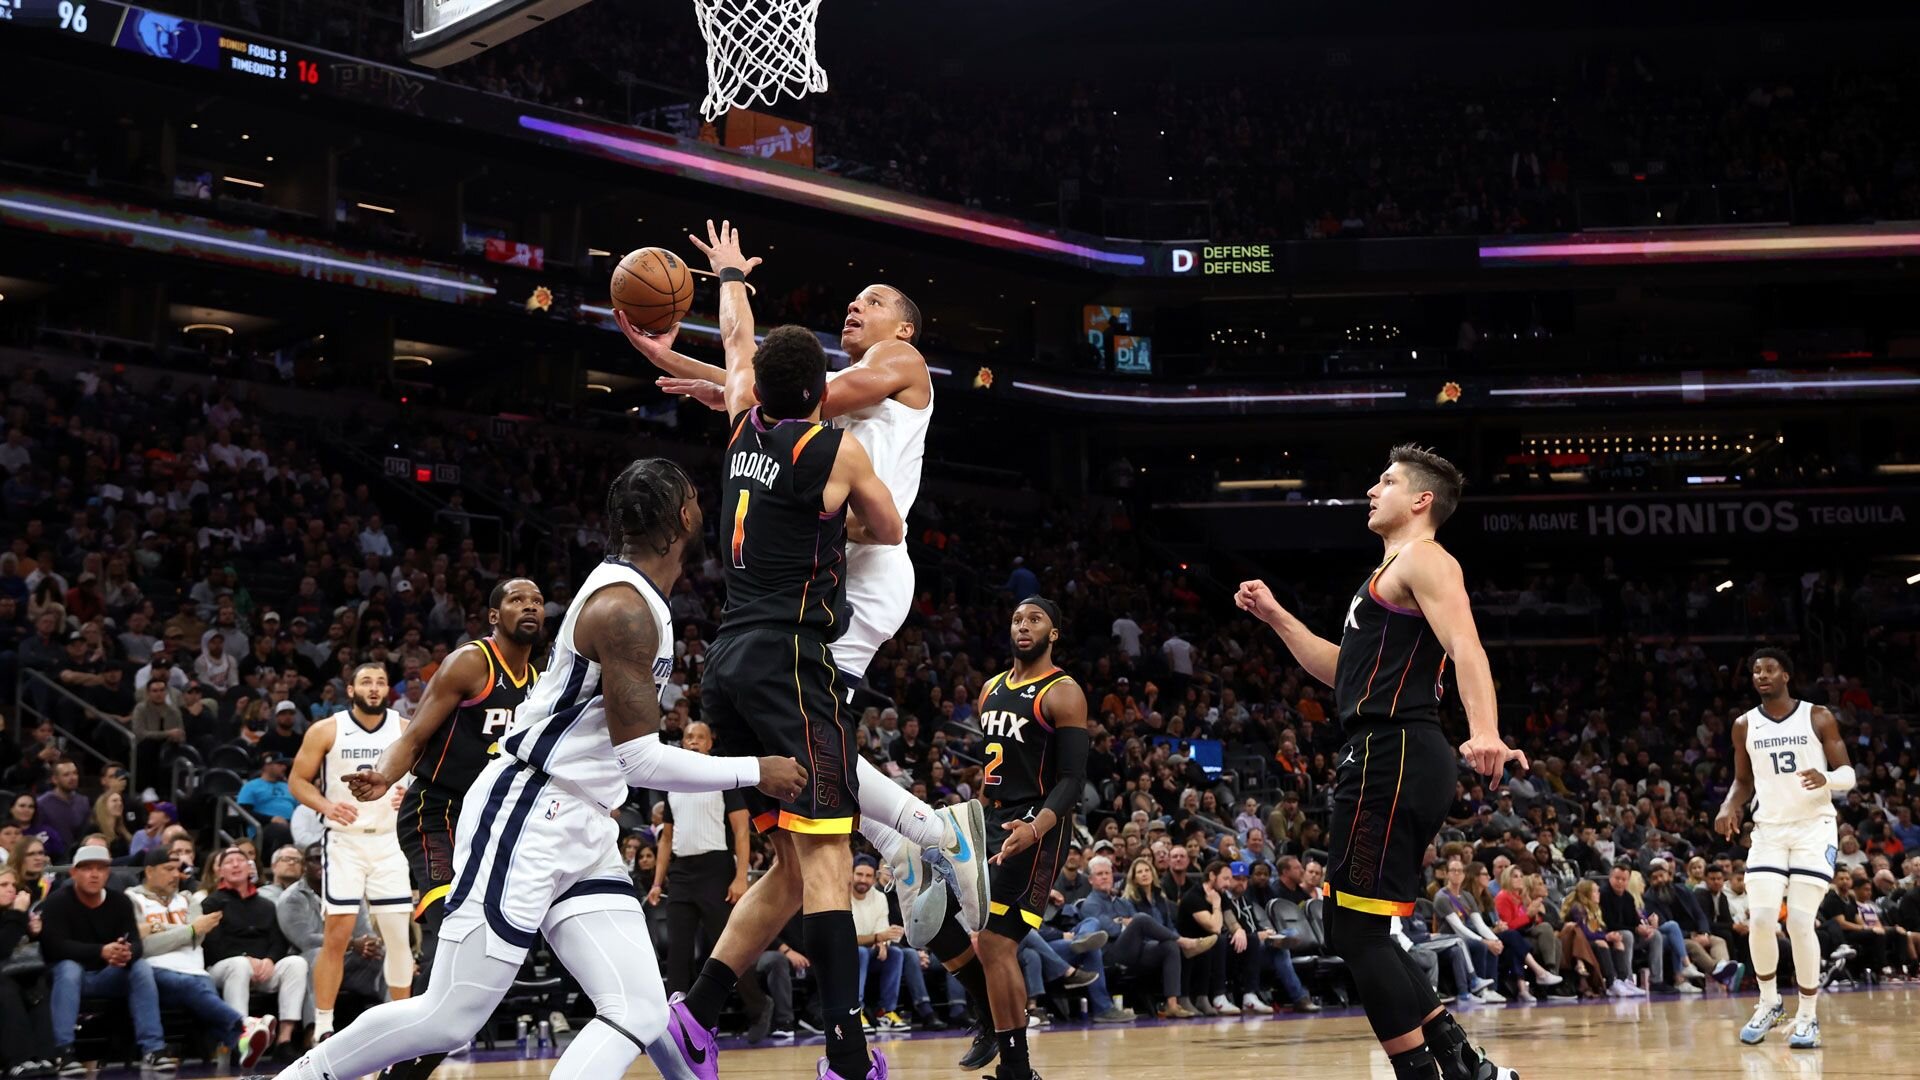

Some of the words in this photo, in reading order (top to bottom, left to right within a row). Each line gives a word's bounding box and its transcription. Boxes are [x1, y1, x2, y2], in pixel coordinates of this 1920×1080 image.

[58, 0, 88, 33] 96
[230, 56, 276, 78] TIMEOUTS
[279, 66, 287, 79] 2
[247, 43, 277, 61] FOULS
[279, 50, 288, 63] 5
[296, 59, 319, 85] 16
[1172, 249, 1193, 272] D
[730, 451, 780, 490] BOOKER
[732, 489, 750, 569] 1
[1483, 513, 1525, 532] 100%
[1528, 512, 1579, 531] AGAVE
[1587, 500, 1800, 536] HORNITOS
[1808, 504, 1906, 525] TEQUILA
[980, 710, 1030, 744] PHX
[1753, 735, 1808, 750] MEMPHIS
[984, 742, 1004, 786] 2
[1769, 751, 1797, 775] 13
